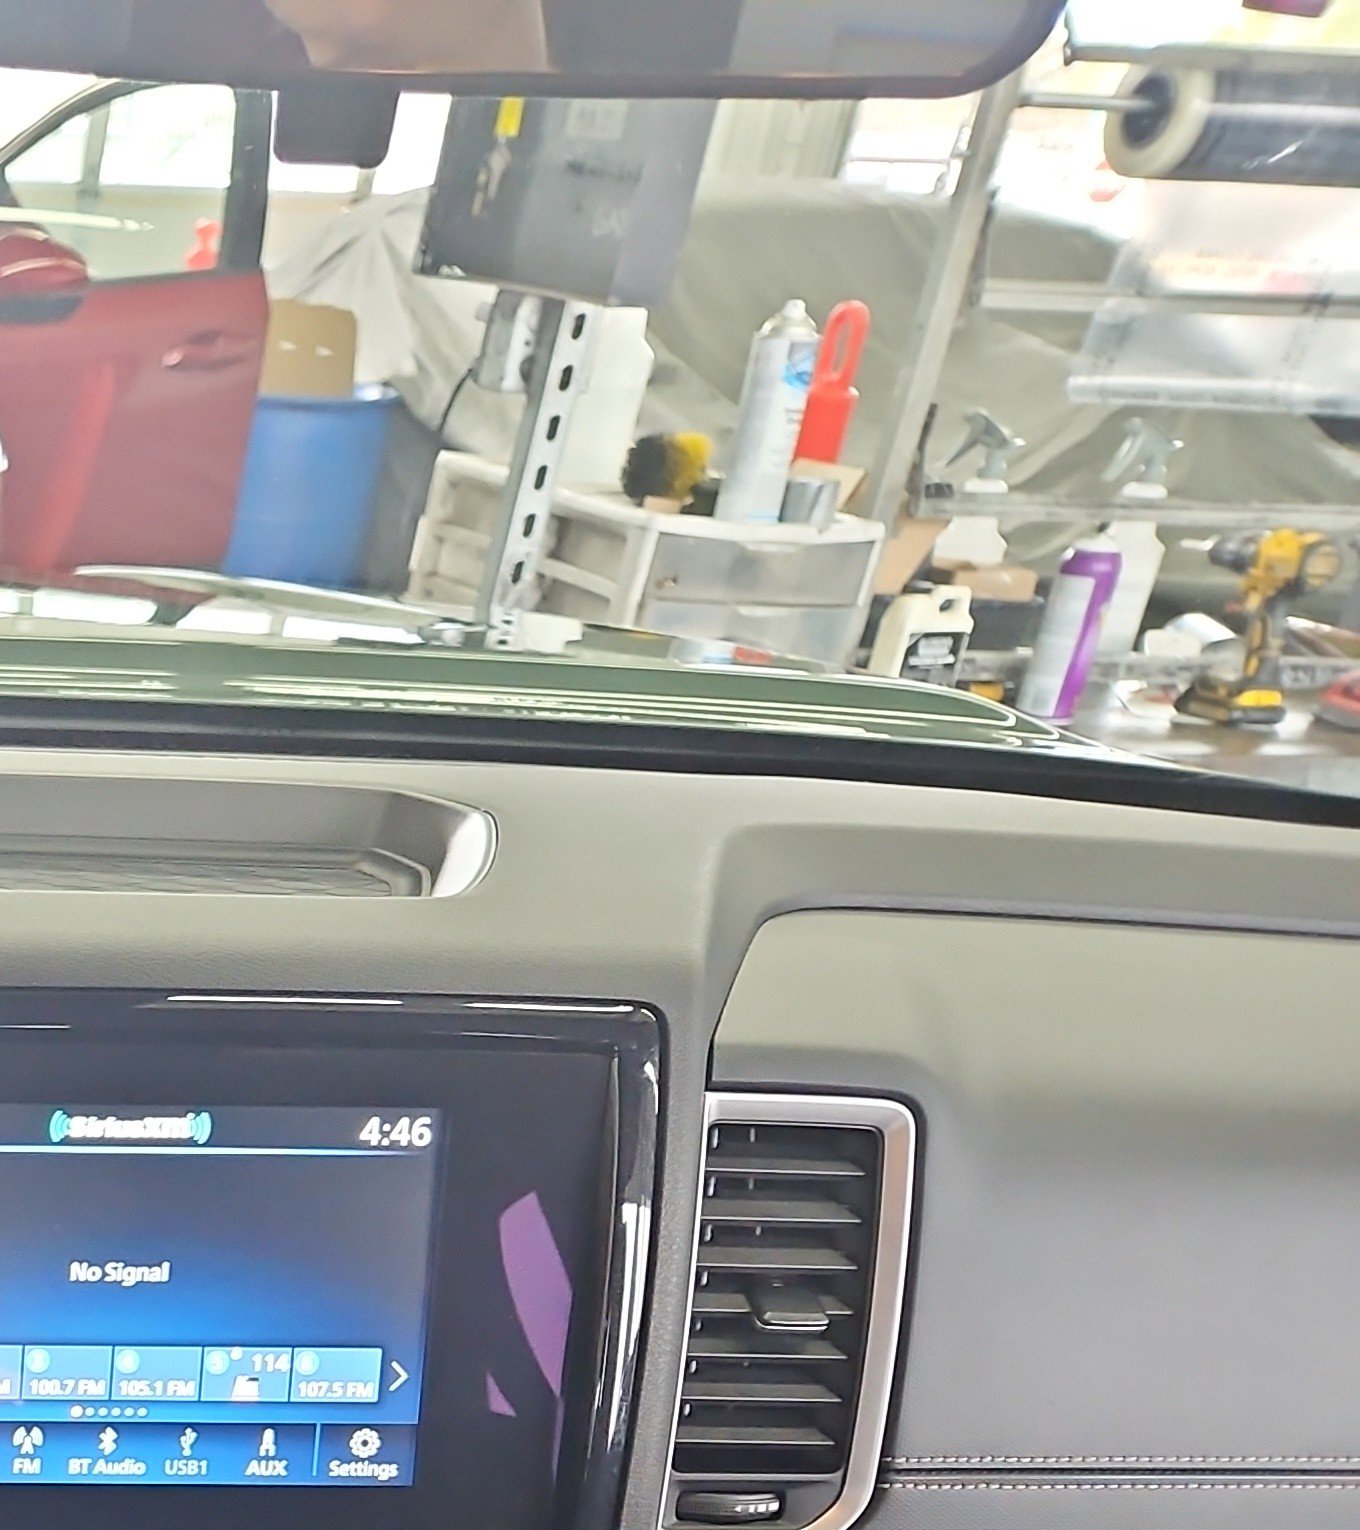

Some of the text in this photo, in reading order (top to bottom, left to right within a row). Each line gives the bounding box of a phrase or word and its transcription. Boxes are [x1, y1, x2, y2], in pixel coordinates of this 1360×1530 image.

[359, 1115, 432, 1147] 4:46
[69, 1261, 171, 1287] No Signal
[250, 1352, 291, 1373] 114
[79, 1379, 107, 1396] FM
[118, 1379, 197, 1397] 105.1 FM
[297, 1380, 375, 1399] 107.5 FM
[12, 1457, 42, 1475] FM
[67, 1458, 147, 1475] BT Audio
[164, 1459, 208, 1476] USB1
[244, 1459, 288, 1477] AUX
[328, 1460, 400, 1481] Settings
